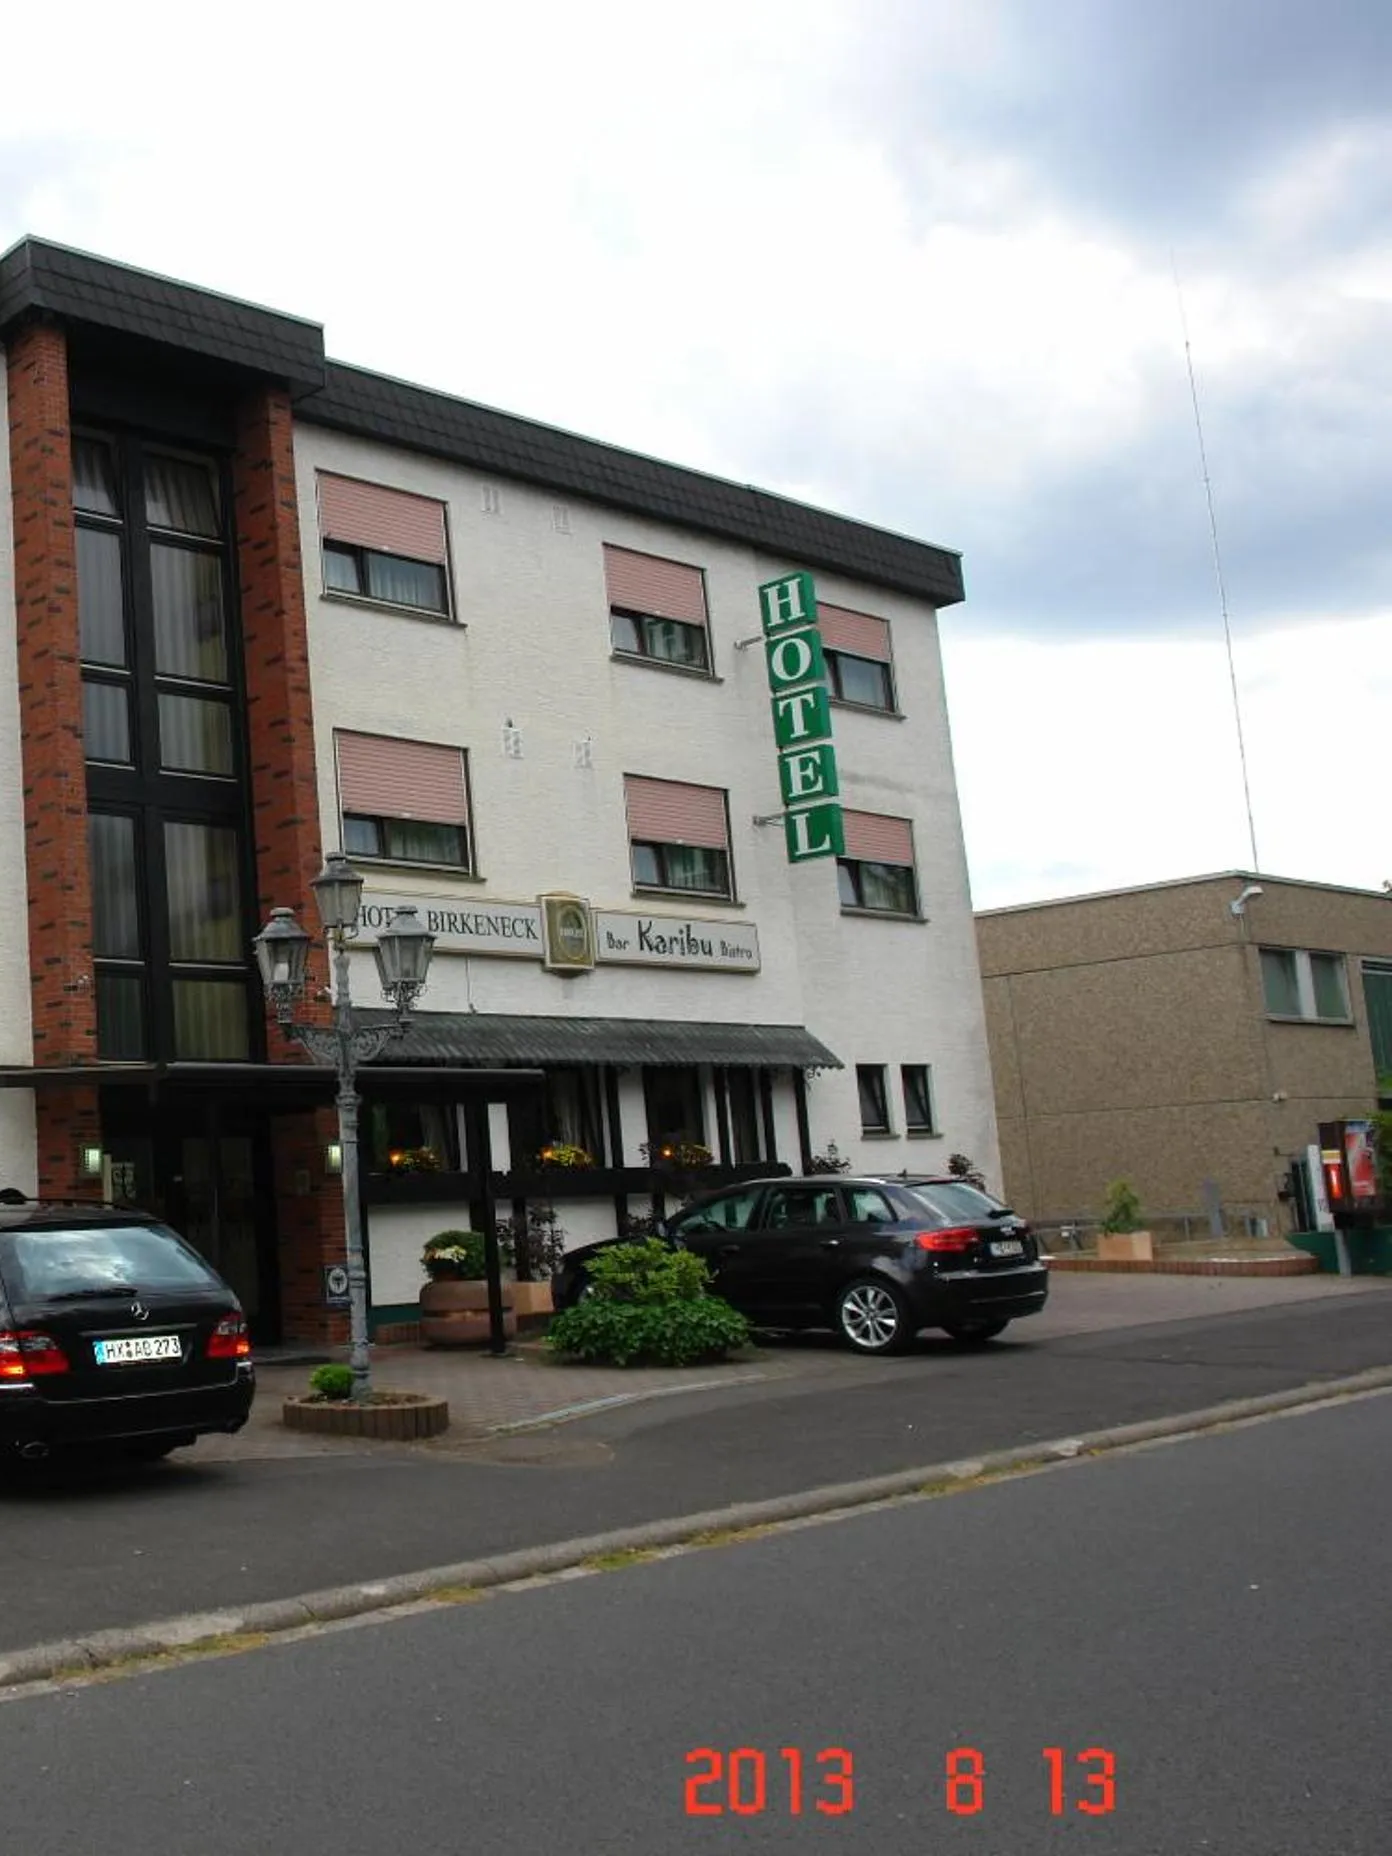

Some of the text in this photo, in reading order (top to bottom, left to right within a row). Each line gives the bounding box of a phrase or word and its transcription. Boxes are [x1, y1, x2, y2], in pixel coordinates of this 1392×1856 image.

[763, 577, 831, 856] HOTEL
[427, 910, 539, 940] BIRKENECK
[606, 930, 630, 951] Bar
[638, 919, 713, 957] Karibu
